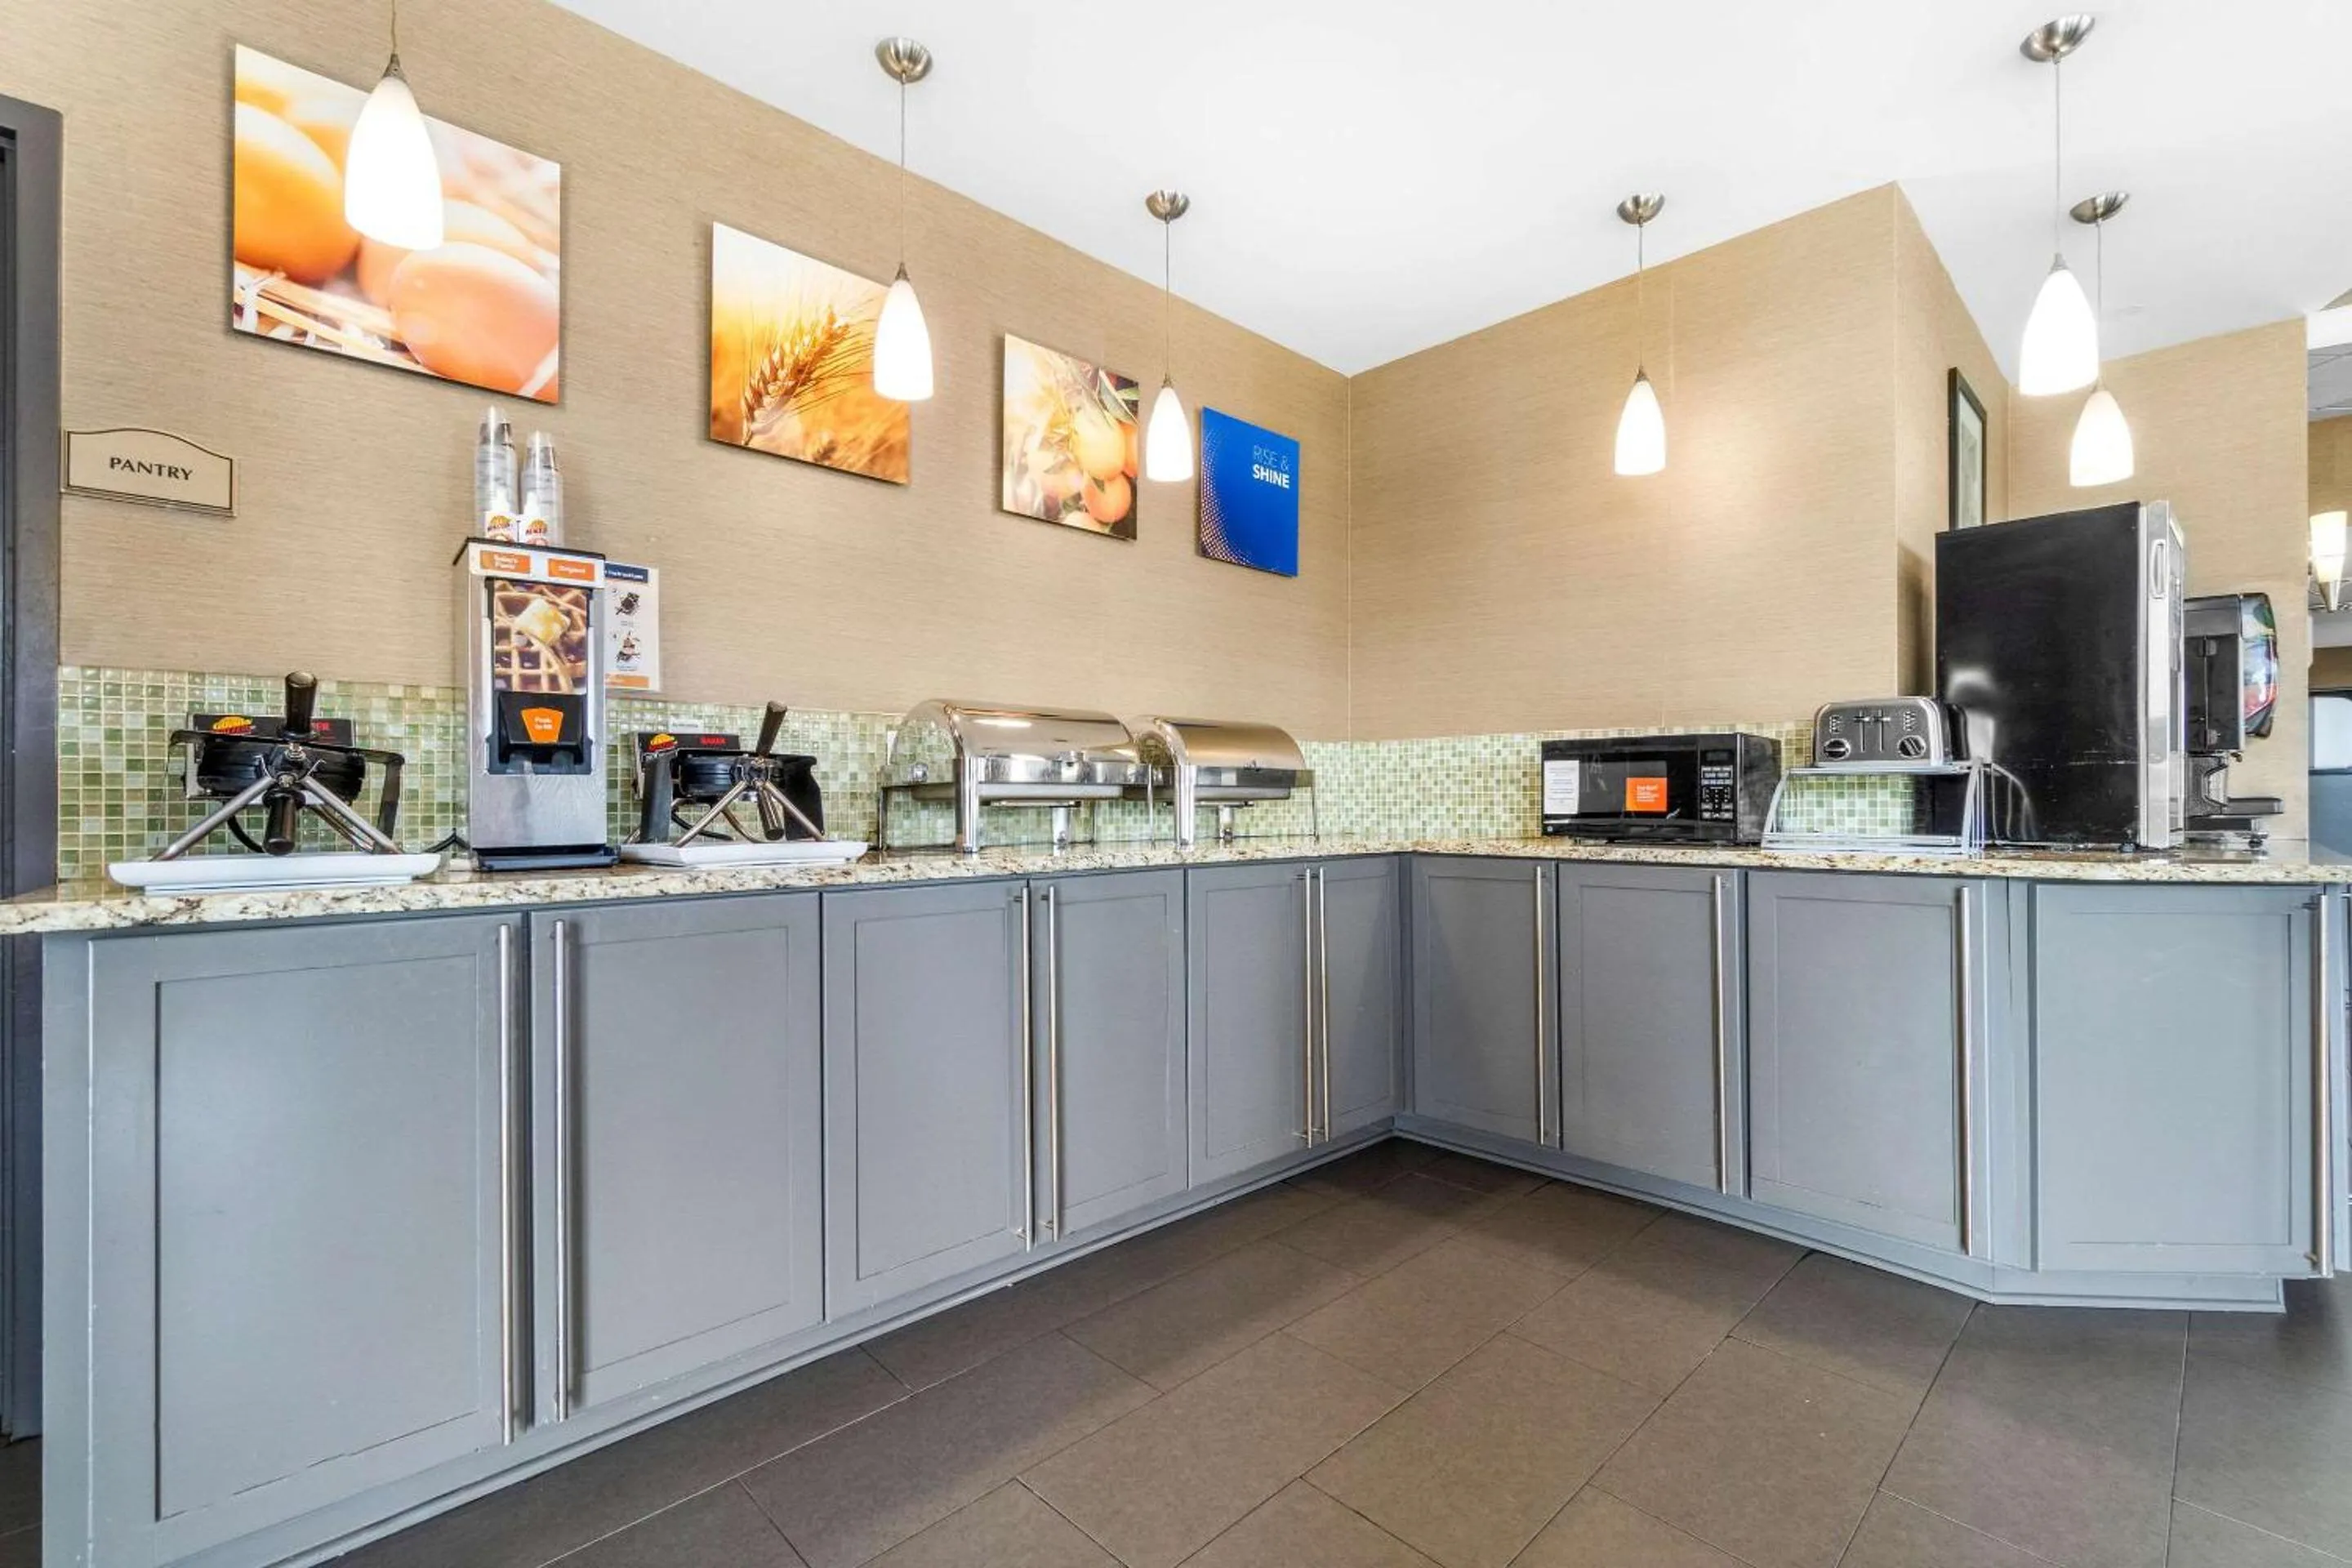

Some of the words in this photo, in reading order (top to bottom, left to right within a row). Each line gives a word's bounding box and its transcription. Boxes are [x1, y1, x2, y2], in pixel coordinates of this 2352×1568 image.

[109, 457, 194, 481] PANTRY
[1254, 445, 1278, 468] RISE
[1281, 455, 1290, 471] &
[1252, 463, 1290, 489] SHINE
